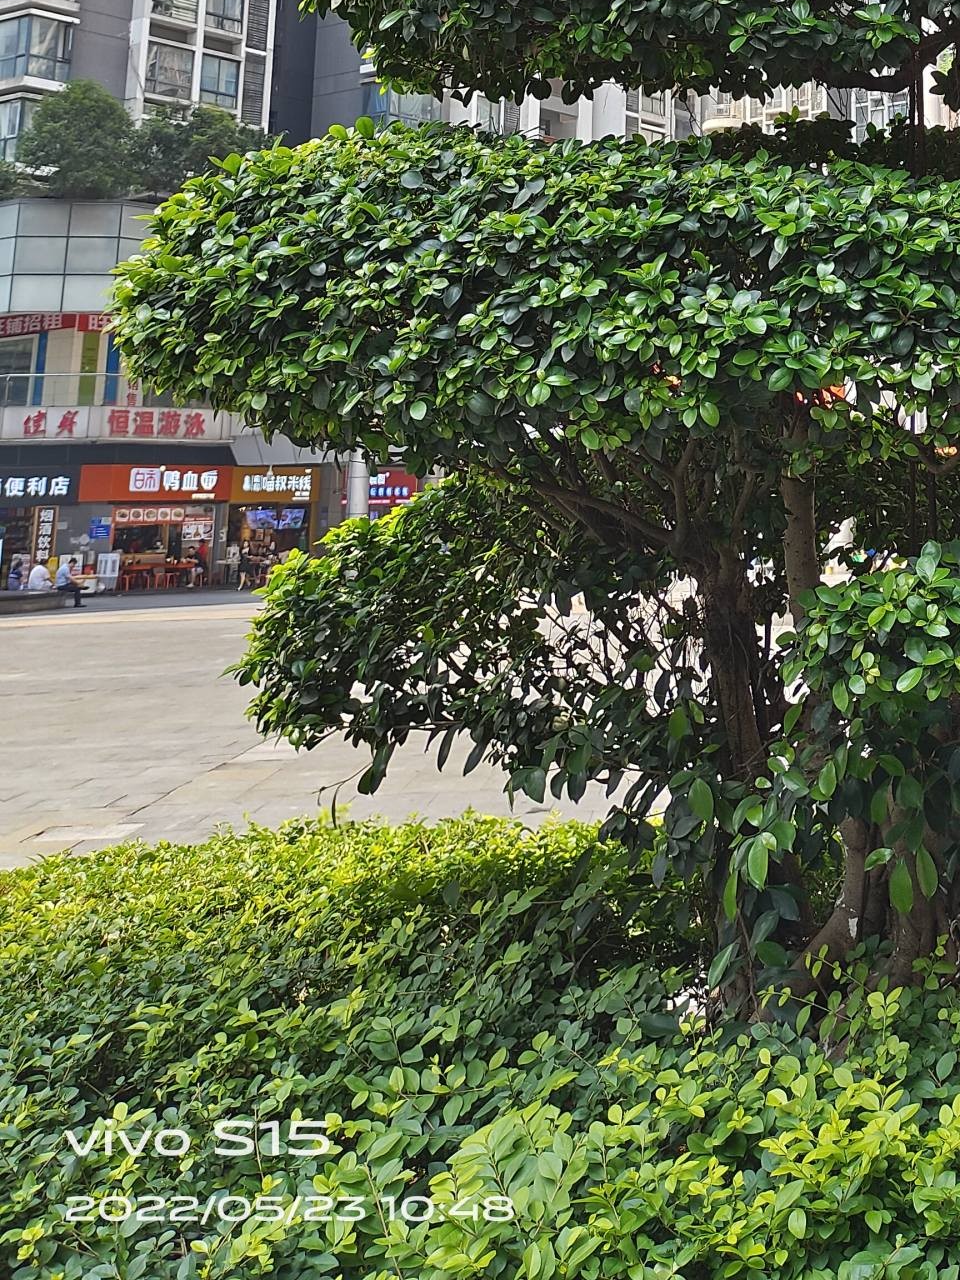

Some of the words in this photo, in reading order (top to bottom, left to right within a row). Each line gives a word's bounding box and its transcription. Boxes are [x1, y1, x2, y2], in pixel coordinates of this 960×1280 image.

[108, 409, 206, 438] 恒温游泳
[0, 477, 70, 497] 便利店
[36, 509, 54, 562] 烟酒饮料
